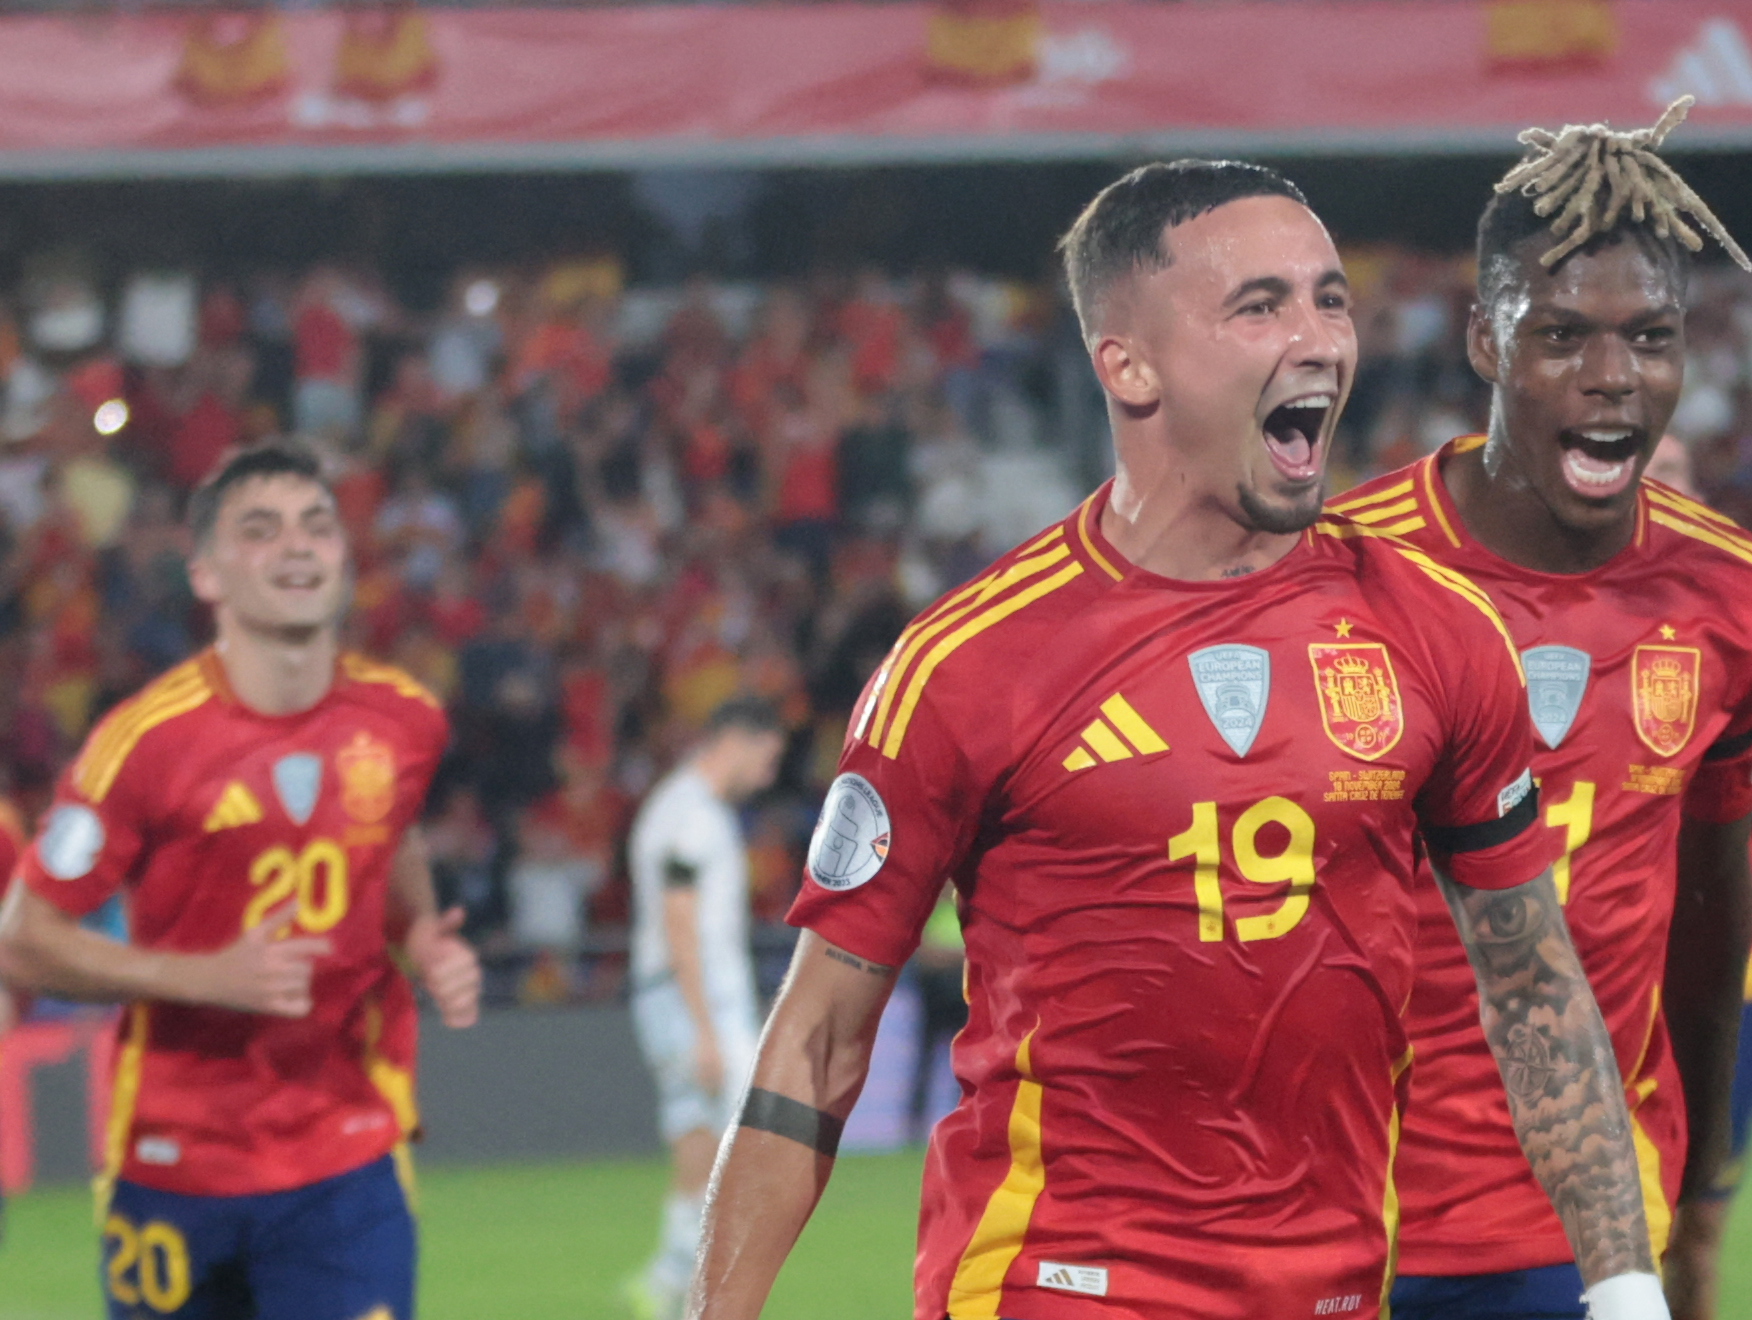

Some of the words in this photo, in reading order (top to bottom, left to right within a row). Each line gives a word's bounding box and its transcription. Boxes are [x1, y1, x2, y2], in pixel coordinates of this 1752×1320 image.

[1198, 661, 1260, 672] EUROPEAN
[1528, 661, 1581, 671] EUROPEAN
[1200, 671, 1262, 681] CHAMPIONS
[1528, 671, 1581, 681] CHAMPIONS
[1223, 718, 1252, 728] 2024
[1329, 771, 1351, 781] SPAIN
[1358, 770, 1405, 780] SWITZERLAND
[1324, 791, 1348, 802] SANTA
[1168, 795, 1316, 943] 19
[242, 837, 347, 938] 20
[105, 1214, 190, 1313] 20
[1314, 1294, 1362, 1315] HEAT.RDY
